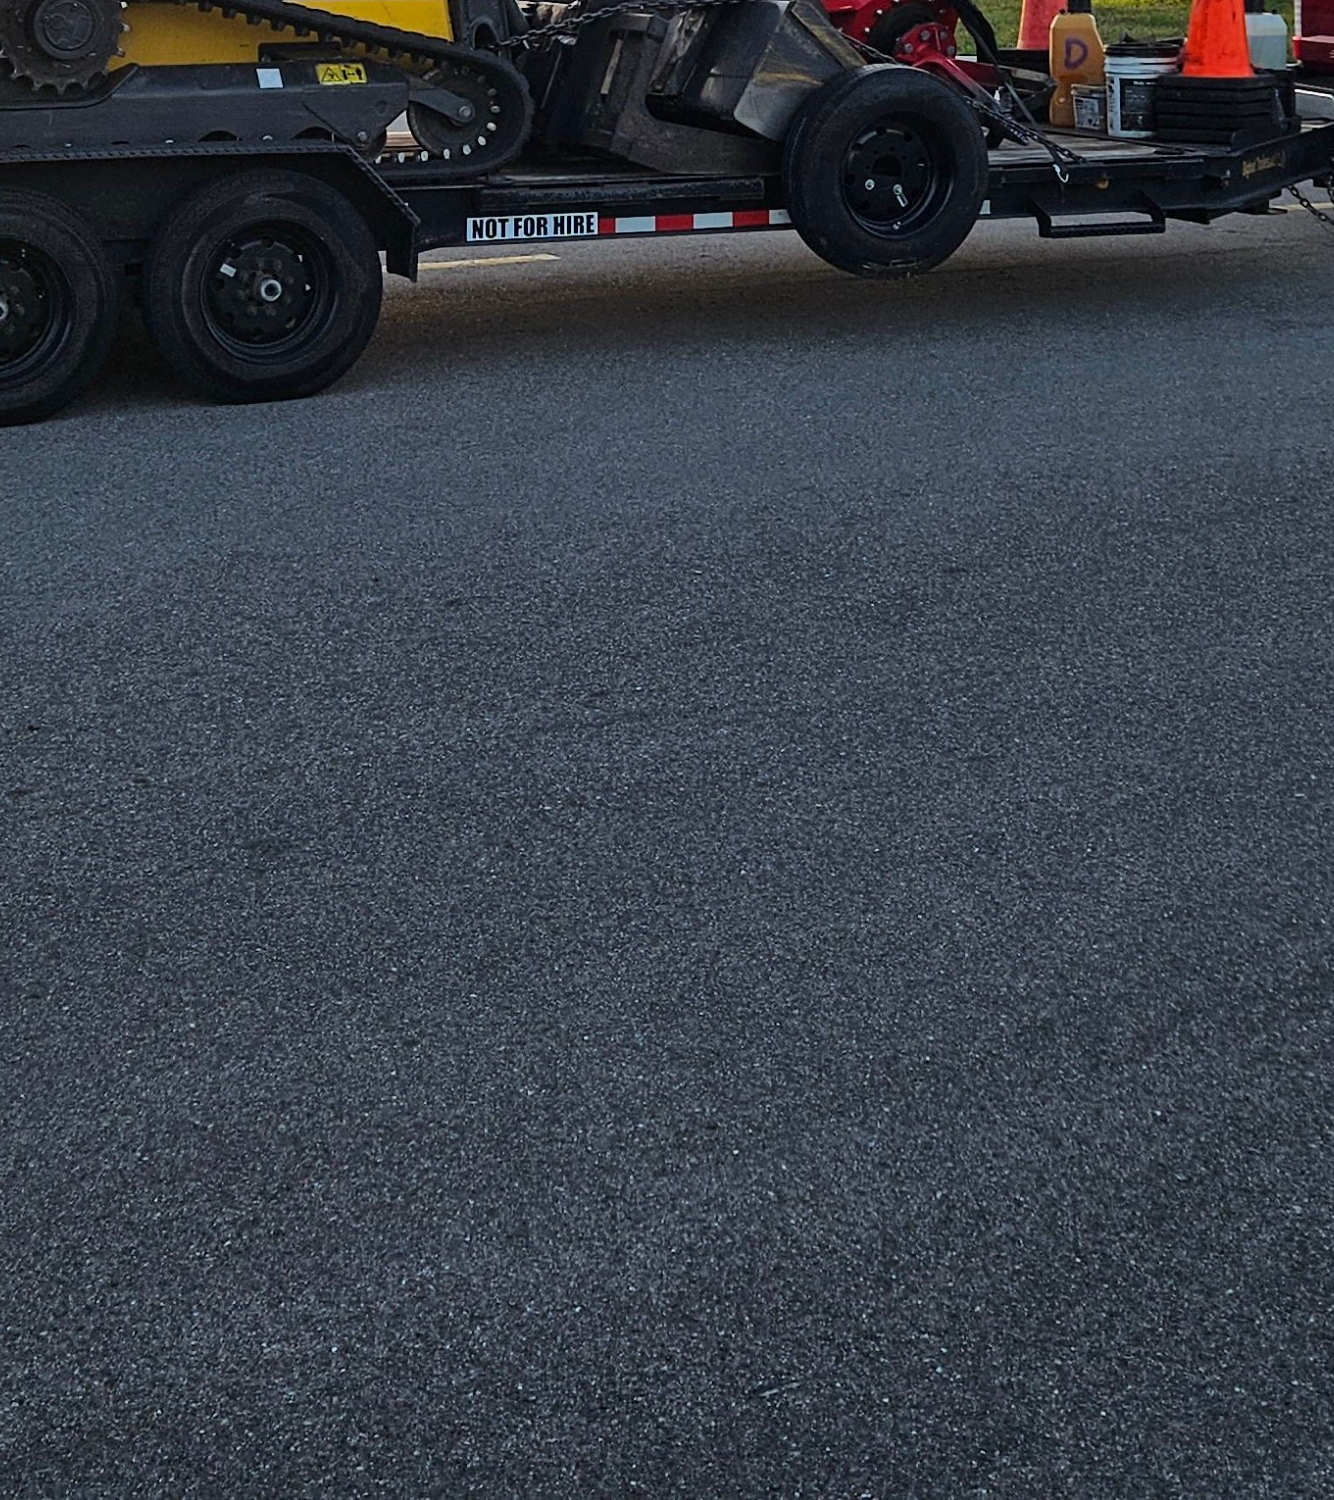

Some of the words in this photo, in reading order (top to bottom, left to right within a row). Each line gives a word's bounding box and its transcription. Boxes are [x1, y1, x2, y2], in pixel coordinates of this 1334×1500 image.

[1064, 37, 1089, 69] D
[472, 218, 509, 239] NOT
[513, 216, 548, 237] FOR
[553, 214, 595, 236] HIRE
